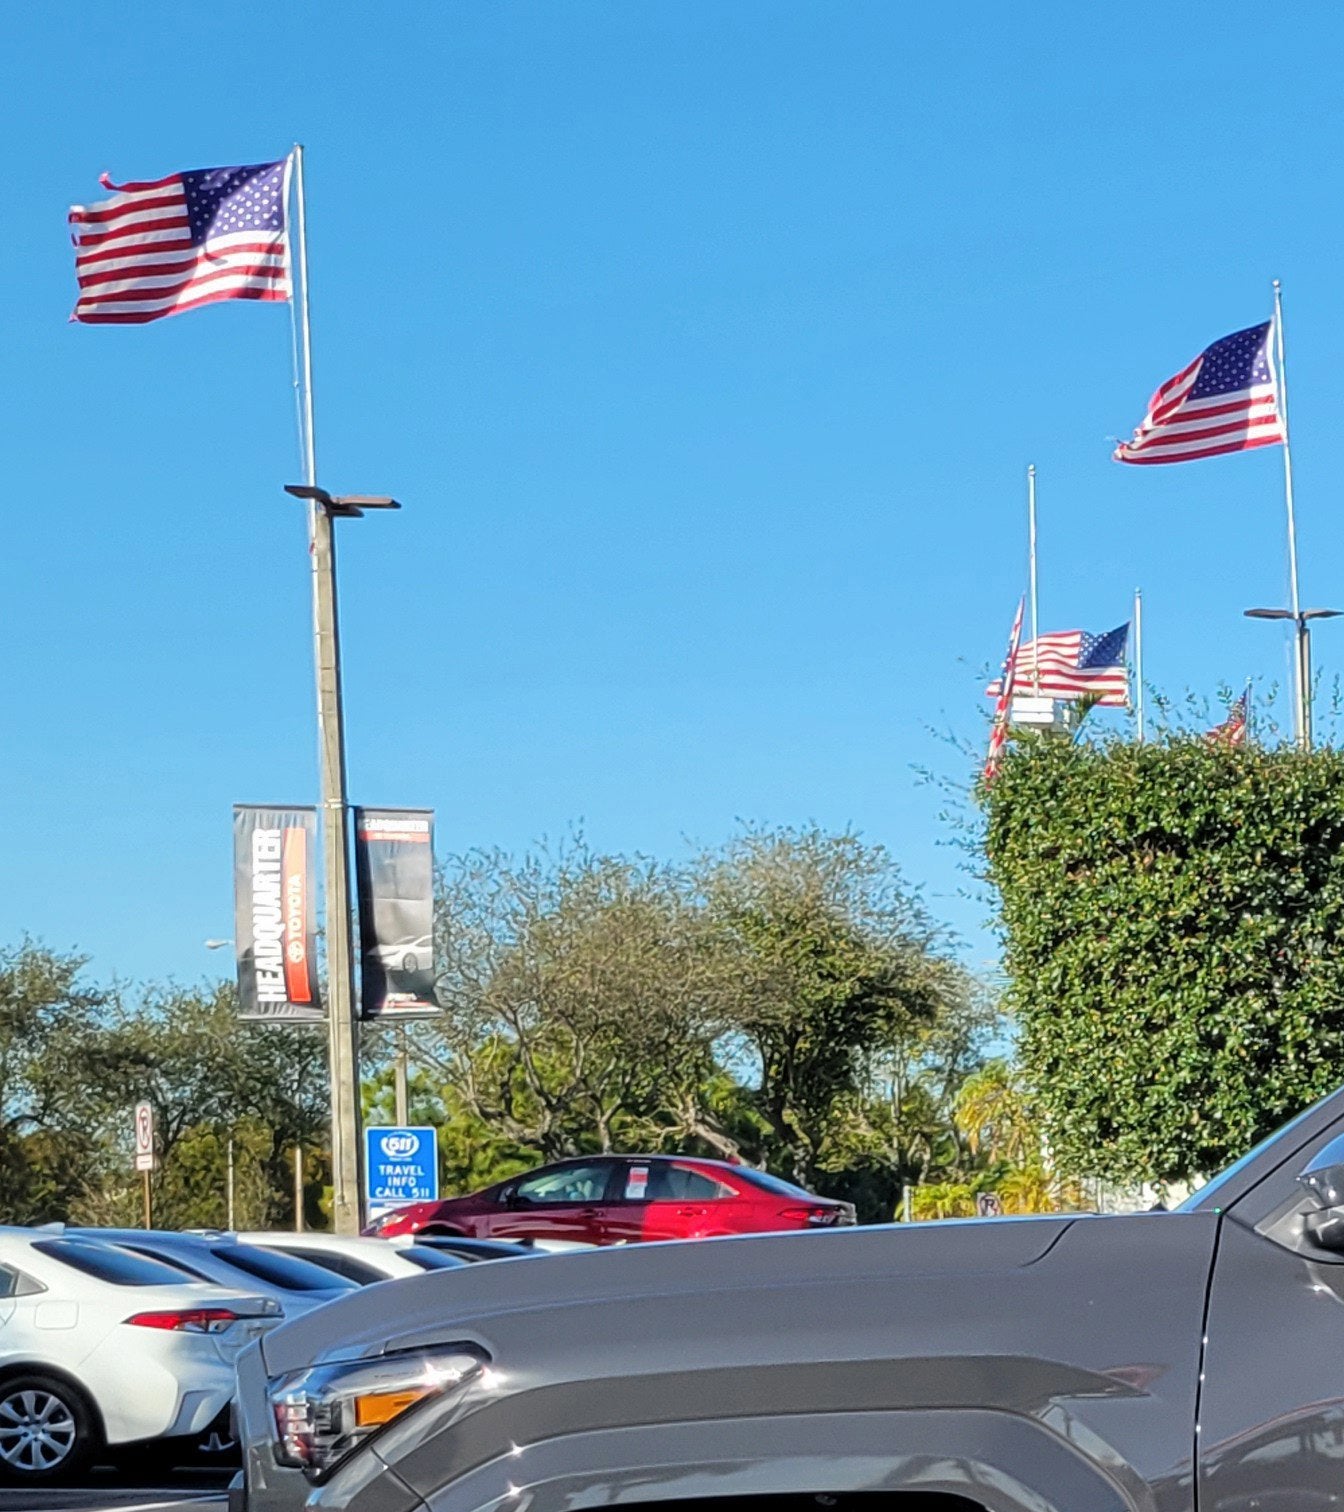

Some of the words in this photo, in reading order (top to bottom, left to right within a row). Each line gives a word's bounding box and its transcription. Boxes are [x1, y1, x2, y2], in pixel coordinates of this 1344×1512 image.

[287, 875, 302, 940] TOYOTA
[252, 829, 288, 1002] HEADQUARTER
[388, 1137, 412, 1151] 511
[379, 1165, 425, 1176] TRAVEL
[388, 1177, 416, 1187] INFO
[375, 1188, 406, 1198] CALL
[412, 1188, 430, 1198] 511
